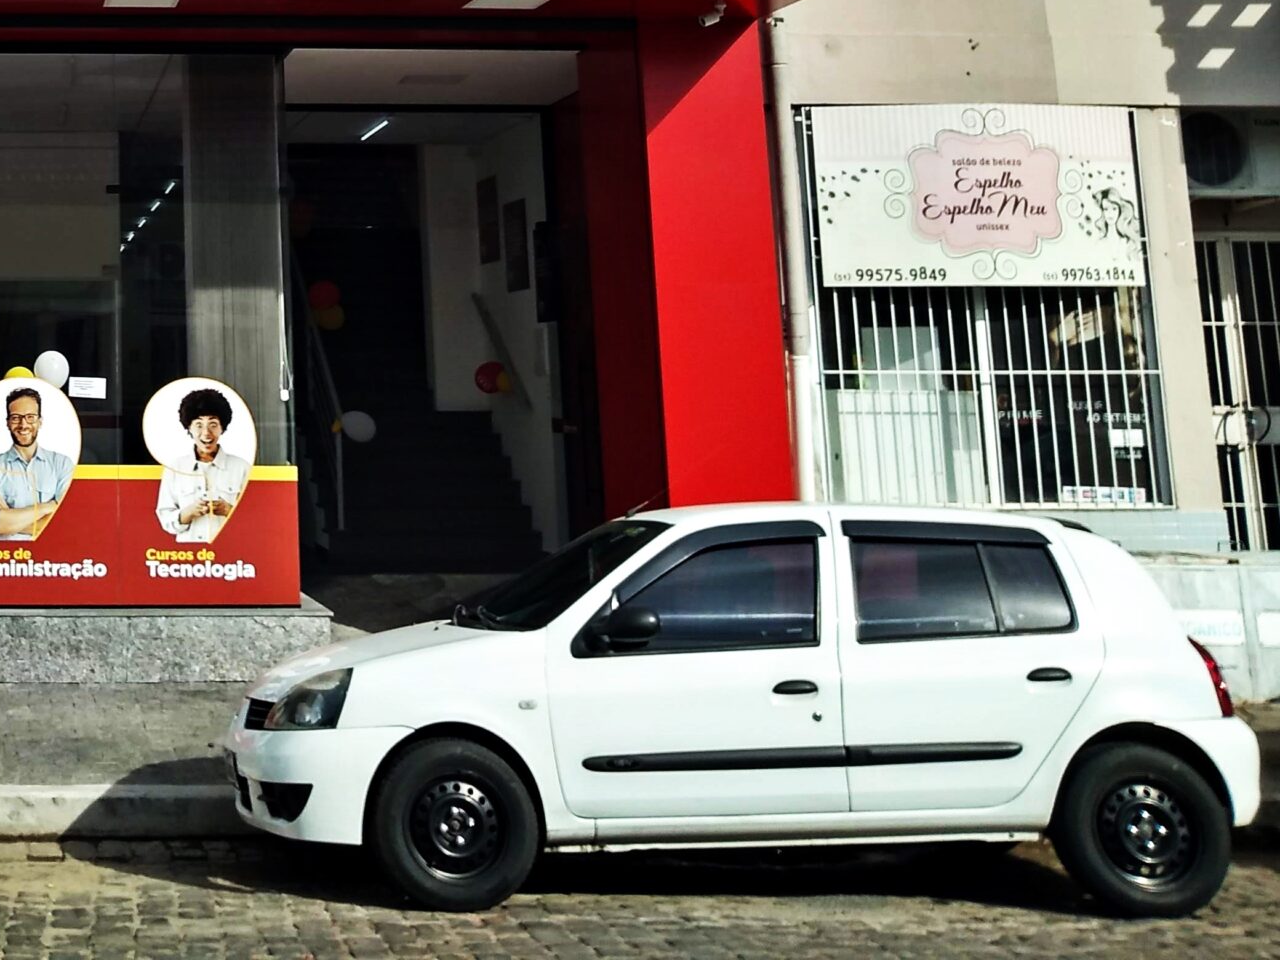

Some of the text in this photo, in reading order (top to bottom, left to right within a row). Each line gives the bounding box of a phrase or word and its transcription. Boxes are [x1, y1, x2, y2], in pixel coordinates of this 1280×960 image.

[980, 158, 990, 166] de
[993, 158, 1022, 166] beleza
[954, 167, 1023, 197] Espelho
[922, 191, 1047, 224] Espelho Meu
[976, 223, 1010, 231] unissex
[855, 266, 947, 282] 99575.9849
[1061, 266, 1136, 282] 99763.1814
[14, 547, 32, 560] de
[146, 548, 215, 561] Cursos de
[146, 560, 255, 581] Tecnologia
